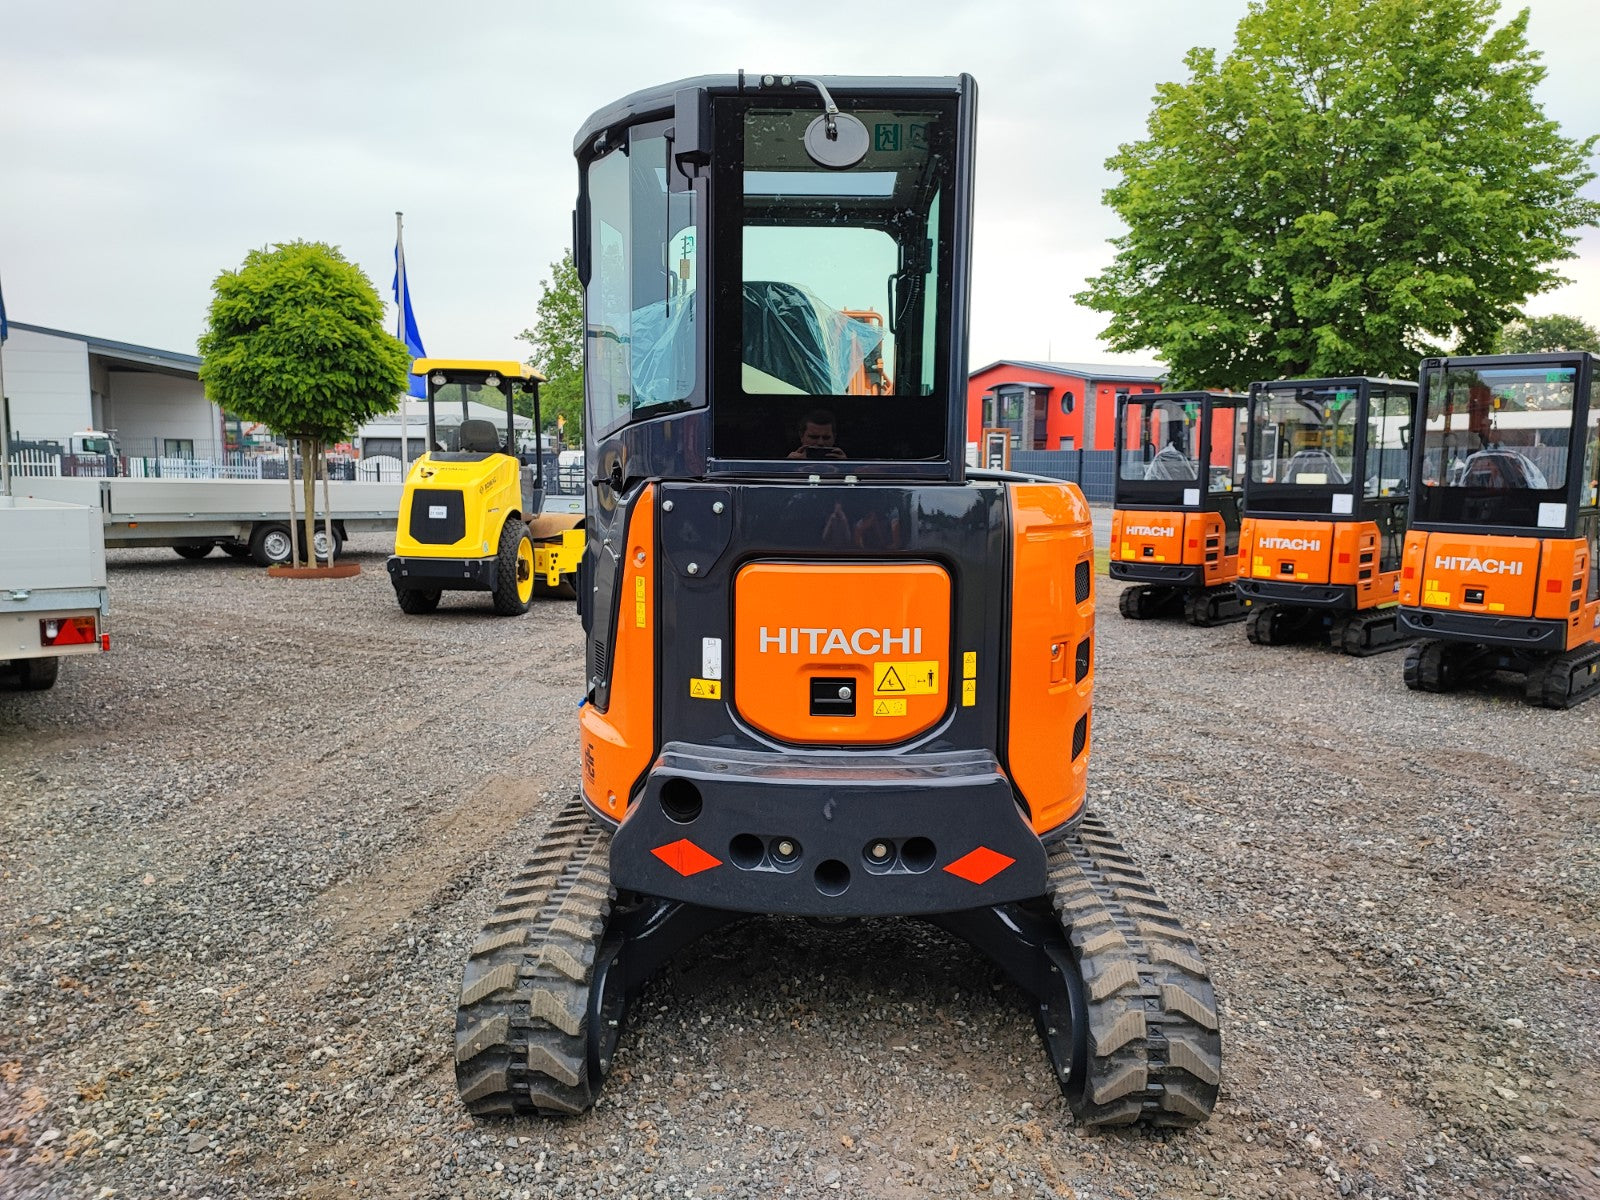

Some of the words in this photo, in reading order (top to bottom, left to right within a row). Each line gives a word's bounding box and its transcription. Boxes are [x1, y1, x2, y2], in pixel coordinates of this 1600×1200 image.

[1126, 526, 1175, 537] HITACHI
[1259, 537, 1321, 551] HITACHI
[1434, 555, 1523, 575] HITACHI
[759, 626, 922, 655] HITACHI
